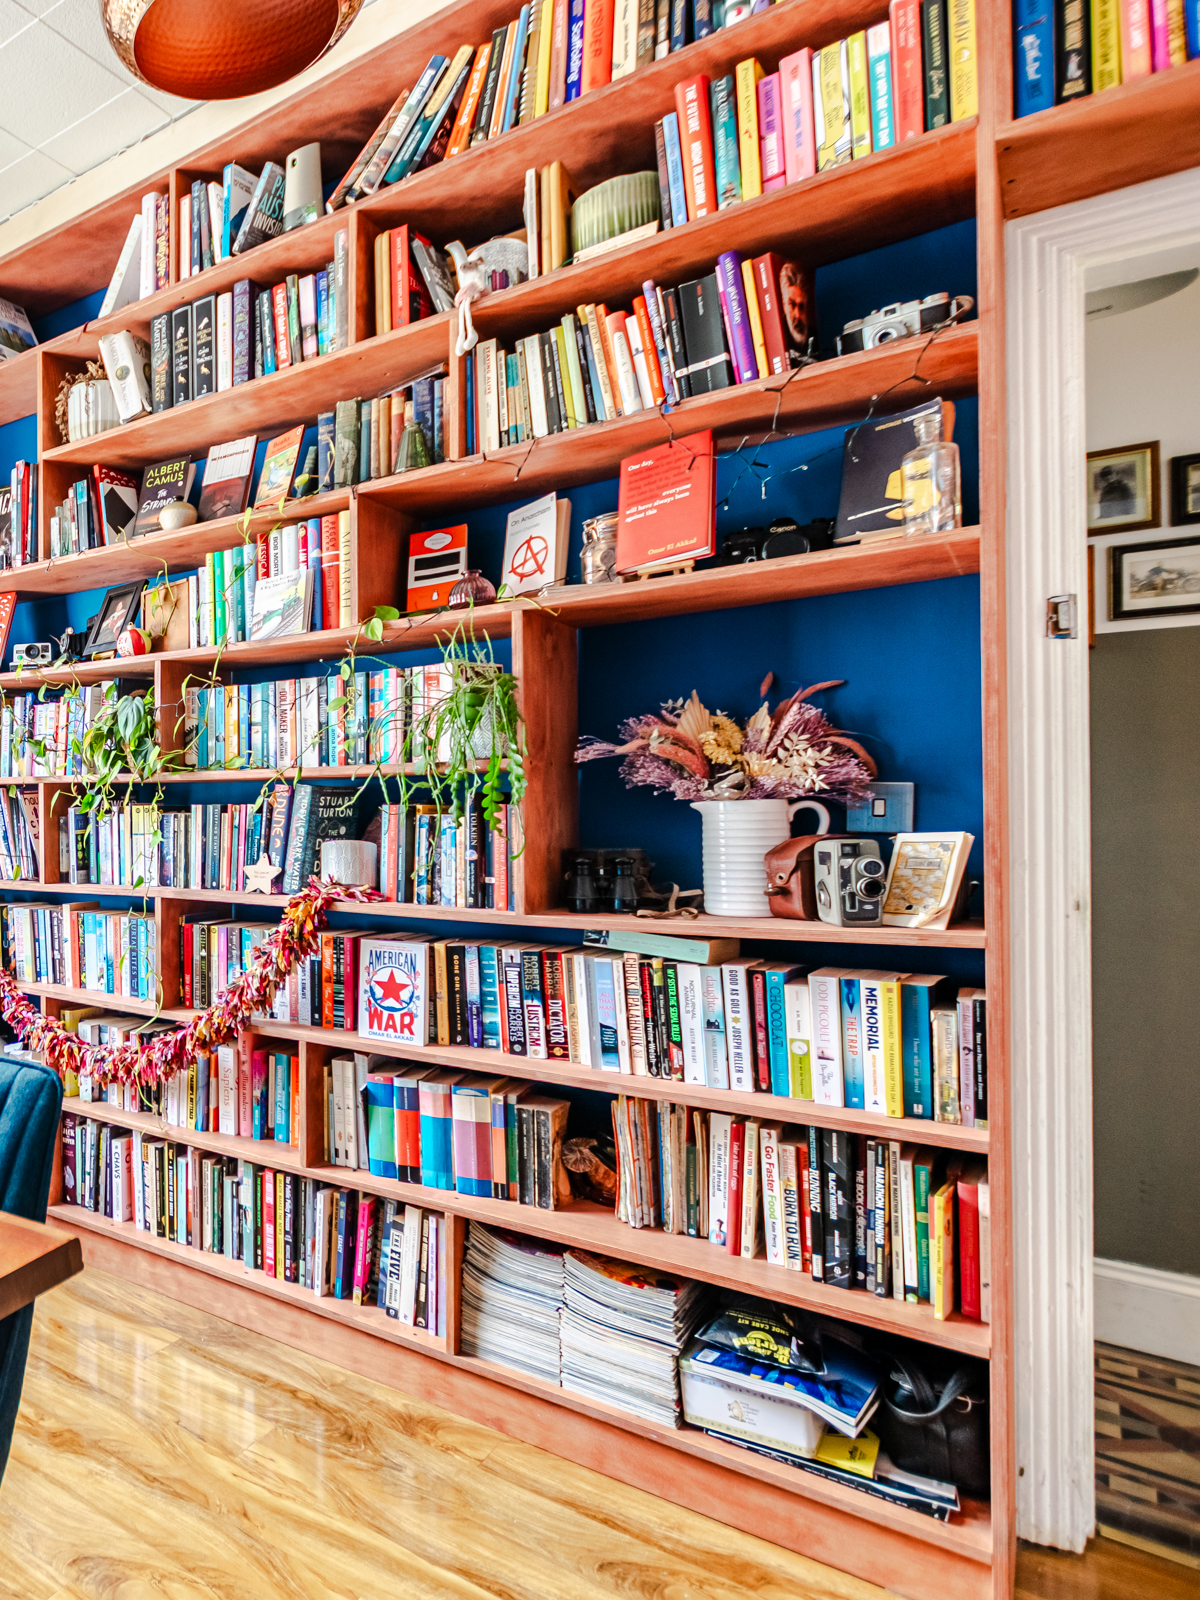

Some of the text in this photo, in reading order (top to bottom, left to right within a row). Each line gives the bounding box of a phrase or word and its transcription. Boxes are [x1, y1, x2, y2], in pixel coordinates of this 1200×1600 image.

[567, 20, 583, 84] Scaffolding
[685, 84, 697, 102] THE
[686, 101, 700, 135] FUTURE
[692, 164, 706, 206] ALDERMAN
[156, 235, 166, 277] BABY LOVE
[274, 292, 286, 315] darker
[277, 315, 286, 334] shade
[643, 330, 651, 350] PHARMACY
[278, 340, 289, 360] magic
[617, 334, 625, 359] Webster
[655, 327, 665, 350] ATWOOD
[661, 355, 670, 378] DEARLY
[146, 461, 187, 479] ALBERT
[211, 448, 250, 462] METAMORPHOSIS
[627, 459, 654, 471] One day,
[145, 472, 184, 488] CAMUS
[662, 483, 692, 496] everyone
[510, 506, 552, 527] On Anarchism
[624, 507, 657, 522] against this
[625, 491, 690, 515] will have always been
[328, 521, 337, 547] PEGGY
[769, 525, 797, 533] Canon
[259, 543, 268, 573] JESSICA
[647, 546, 666, 555] Omar
[675, 537, 697, 549] Akkad
[341, 531, 351, 608] MO FARAH
[327, 581, 336, 597] Time
[326, 602, 335, 617] Ever
[279, 690, 288, 734] DOLL MAKER
[346, 686, 356, 720] ESCAPE
[318, 807, 353, 818] TURTON
[319, 796, 354, 807] STUART
[272, 798, 287, 837] DUNE
[291, 803, 308, 890] DEVIL DARK WATER
[501, 855, 505, 863] OF
[323, 949, 332, 970] Bunny
[368, 950, 417, 981] AMERICAN
[523, 956, 532, 991] HARRIS
[531, 956, 540, 992] ROBERT
[468, 958, 478, 993] Winterkill
[505, 967, 520, 1008] IMPERIUM
[544, 960, 554, 996] HARRIS
[553, 960, 563, 995] ROBERT
[626, 957, 643, 1047] CHUCK PALAHNIUK
[642, 967, 653, 1018] TRAINSPOTTING
[683, 985, 691, 1014] ANIMALS
[688, 980, 697, 1020] NOCTURNAL
[367, 998, 416, 1037] WAR
[509, 1008, 517, 1042] HARRIS
[515, 1008, 524, 1042] ROBERT
[526, 1004, 542, 1047] LUSTRUM
[548, 999, 565, 1043] DICTATOR
[702, 976, 719, 1014] daughter
[711, 1048, 719, 1072] SHEMILT
[728, 969, 744, 1074] GOOD AS GOLD JOSEPH HELLER
[769, 986, 783, 1047] CHOCOLAT
[816, 981, 830, 1043] JODI PICOULT
[865, 987, 879, 1051] MEMORIAL
[570, 1021, 578, 1053] FLASHMAN
[647, 1022, 655, 1042] Irvine
[757, 1032, 766, 1058] Mr Toppit
[846, 1016, 858, 1056] THE TRAP
[221, 1066, 232, 1106] Sapiens
[240, 1069, 248, 1090] gillian
[717, 1142, 723, 1151] An
[765, 1145, 774, 1160] Go
[747, 1168, 753, 1176] TO
[766, 1162, 777, 1193] Faster
[856, 1170, 864, 1182] THE
[809, 1168, 820, 1213] RUNNING
[828, 1172, 838, 1221] BLACK MIRROR
[856, 1183, 865, 1204] BOOK
[875, 1166, 885, 1245] MARATHON RUNNING
[768, 1194, 779, 1220] Food
[857, 1205, 865, 1214] OF
[784, 1188, 800, 1261] BORN TO RUN
[770, 1233, 778, 1248] Percy
[389, 1249, 401, 1281] FIVE
[737, 1317, 750, 1325] KIT
[751, 1320, 770, 1330] CARE
